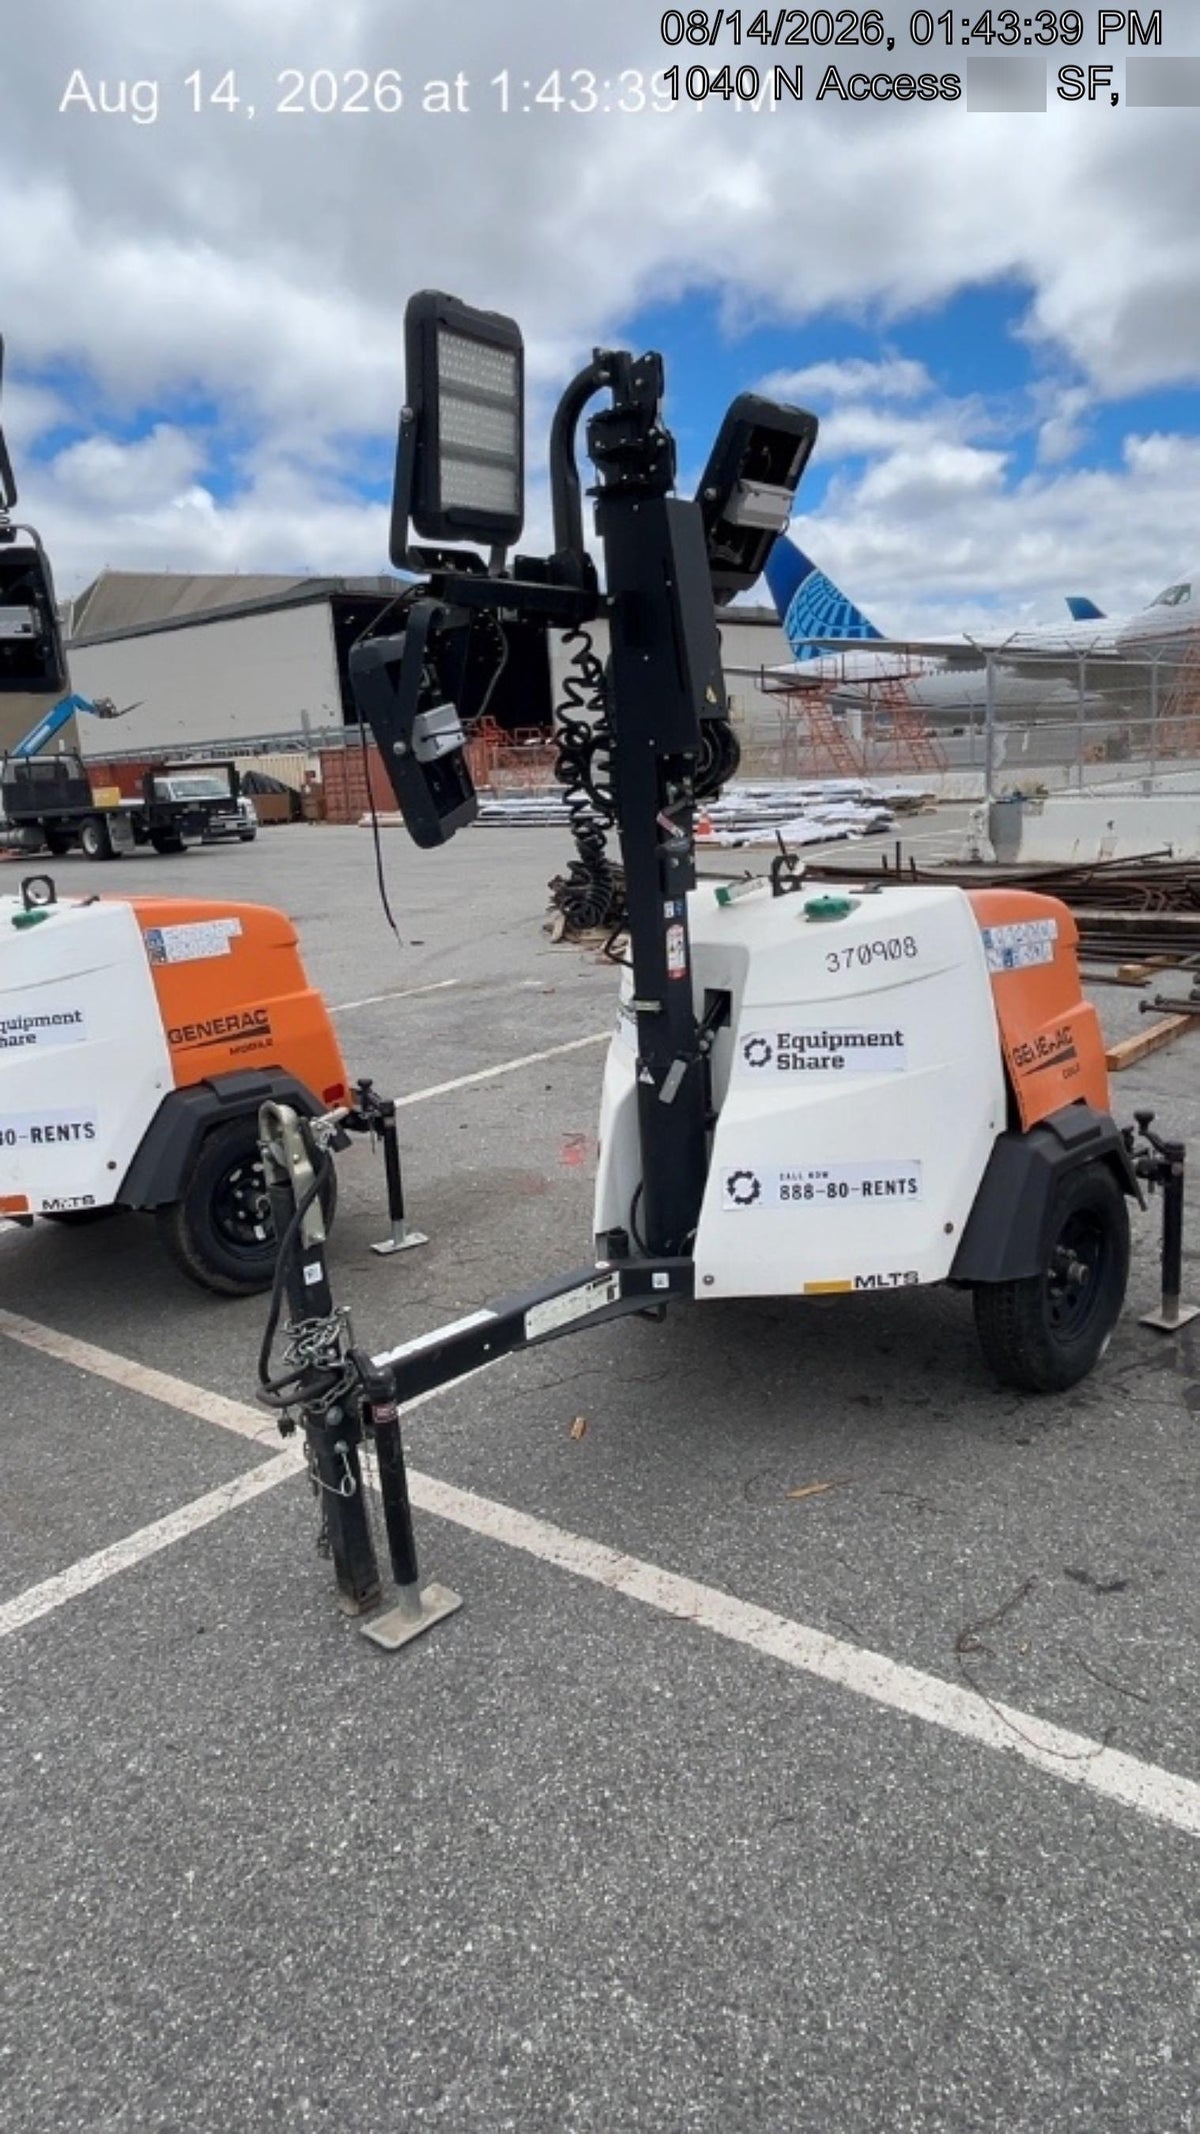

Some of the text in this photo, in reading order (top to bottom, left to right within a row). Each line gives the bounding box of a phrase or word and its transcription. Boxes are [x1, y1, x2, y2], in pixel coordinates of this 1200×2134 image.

[825, 936, 918, 973] 370908
[168, 1009, 268, 1044] GENERAC
[777, 1030, 904, 1052] Equipment
[777, 1053, 845, 1070] Share
[779, 1178, 918, 1200] 888-80-RENTS
[855, 1271, 919, 1288] MLTS
